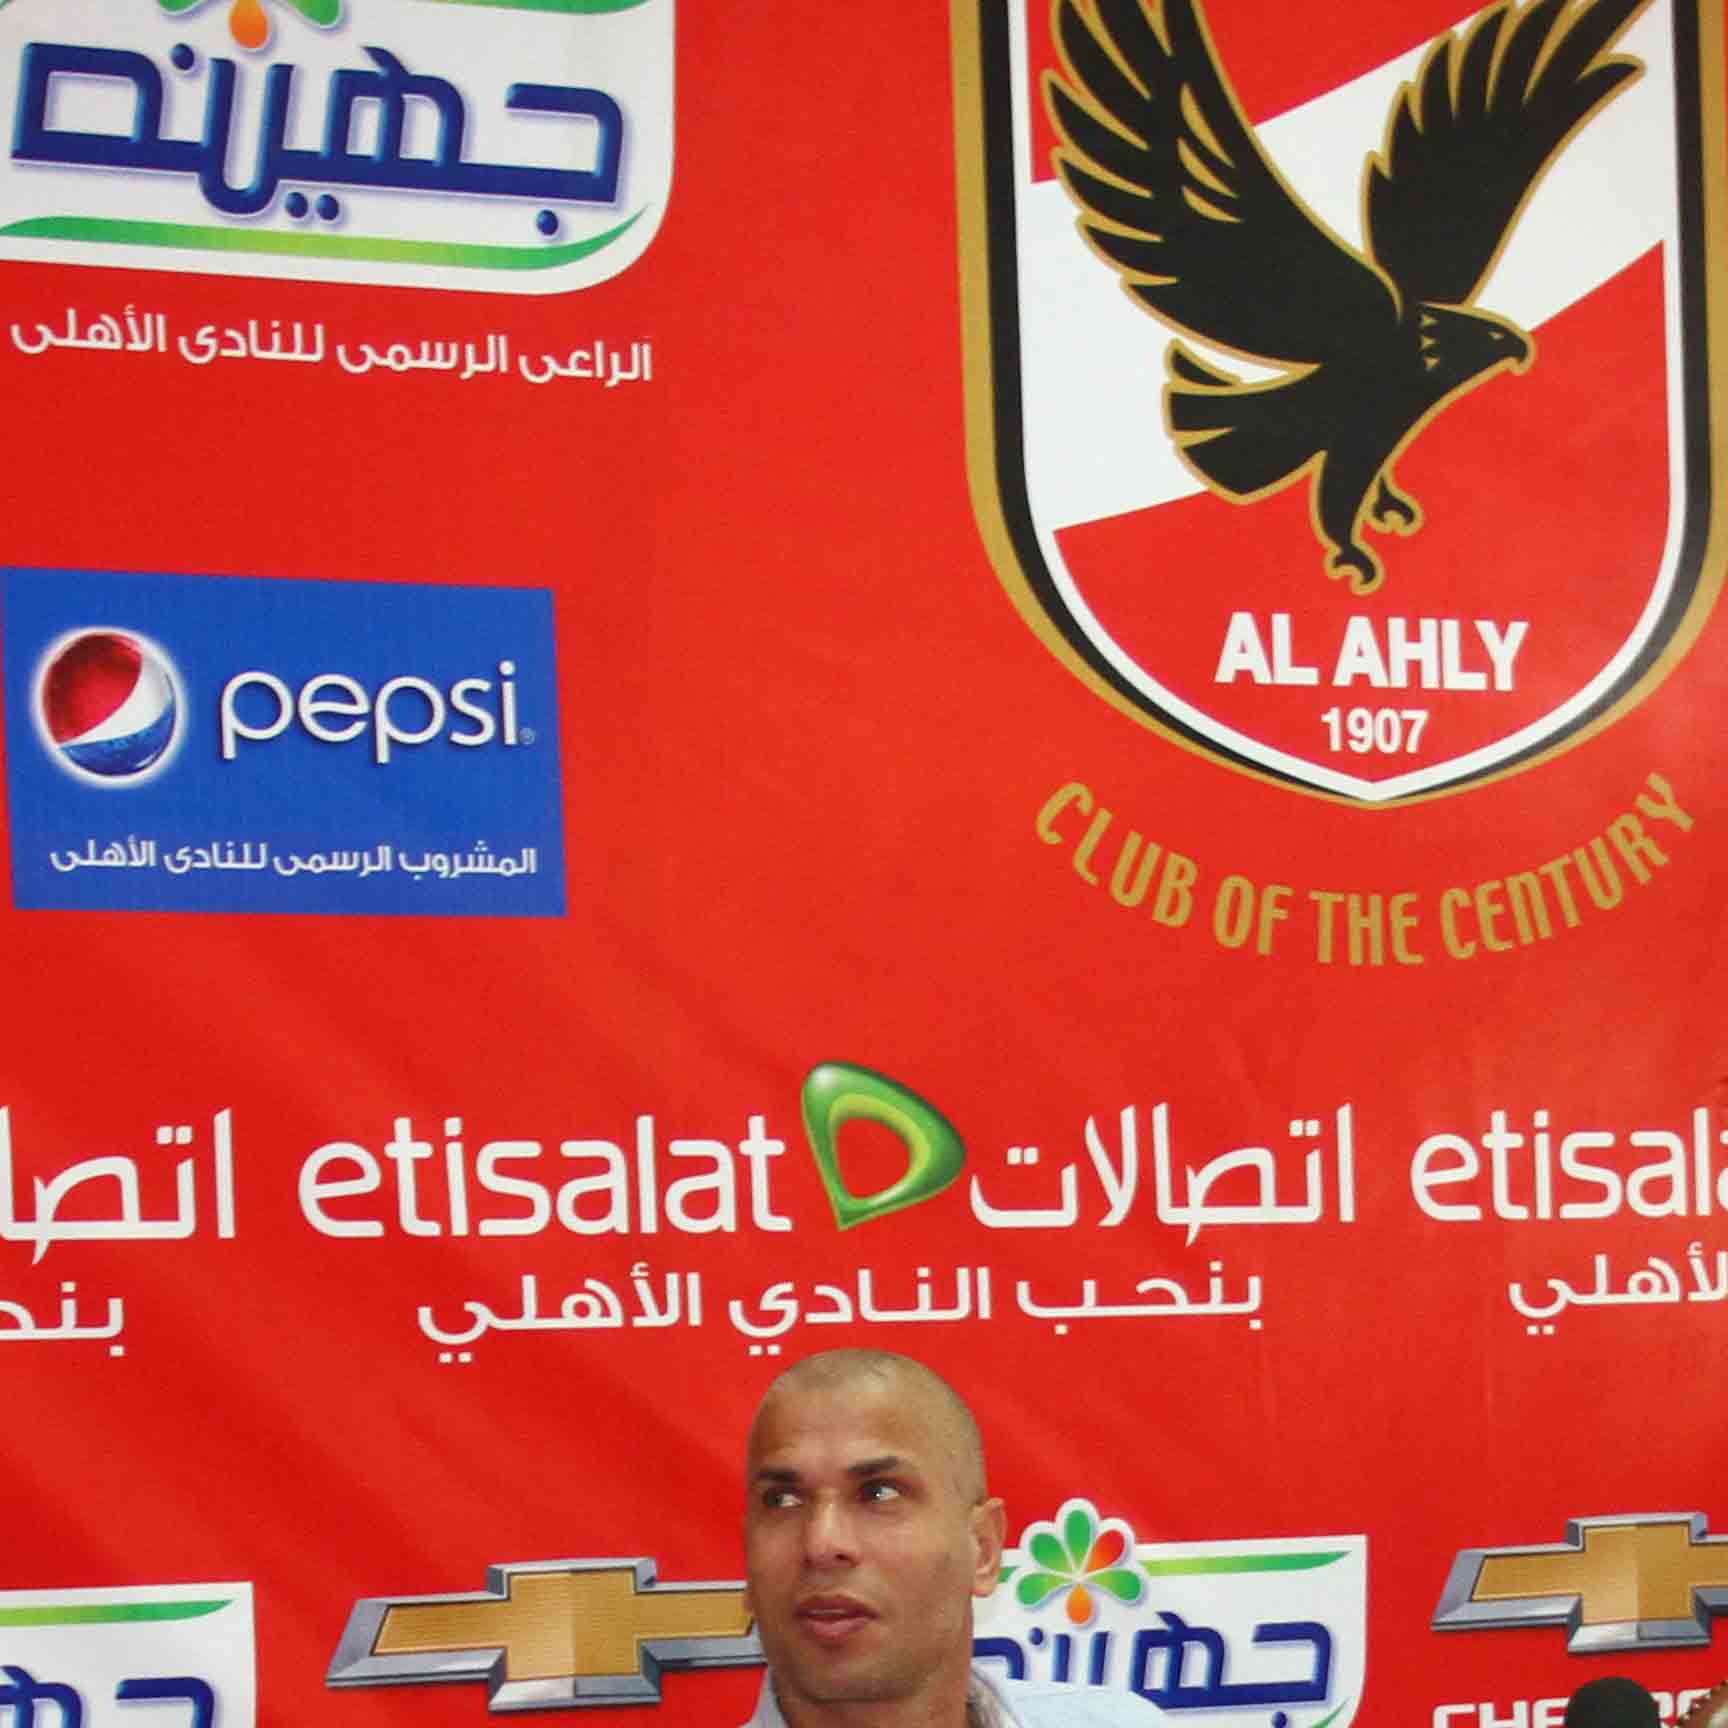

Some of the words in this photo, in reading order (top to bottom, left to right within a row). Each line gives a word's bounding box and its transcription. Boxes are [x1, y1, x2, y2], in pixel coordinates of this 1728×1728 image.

[11, 305, 166, 354] الأهلى
[179, 320, 324, 364] للنادى
[337, 335, 508, 379] الرسمى
[519, 341, 651, 387] الراعى
[1215, 612, 1318, 685] AL
[1333, 616, 1528, 691] AHLY
[222, 661, 516, 763] pepsi
[1322, 708, 1428, 753] 1907
[50, 835, 156, 871] الأهلى
[164, 842, 267, 874] للنادى
[273, 846, 392, 876] الرسمى
[399, 840, 536, 880] المشروب
[1034, 781, 1195, 928] CLUB
[1212, 873, 1294, 957] OF
[1309, 890, 1425, 967] THE
[1439, 771, 1696, 959] CENTURY
[299, 1115, 792, 1237] etisalat
[971, 1103, 1355, 1245] اتصالات
[419, 1262, 702, 1363] الأهلي
[729, 1267, 991, 1355] النادي
[1017, 1262, 1262, 1334] بنحب
